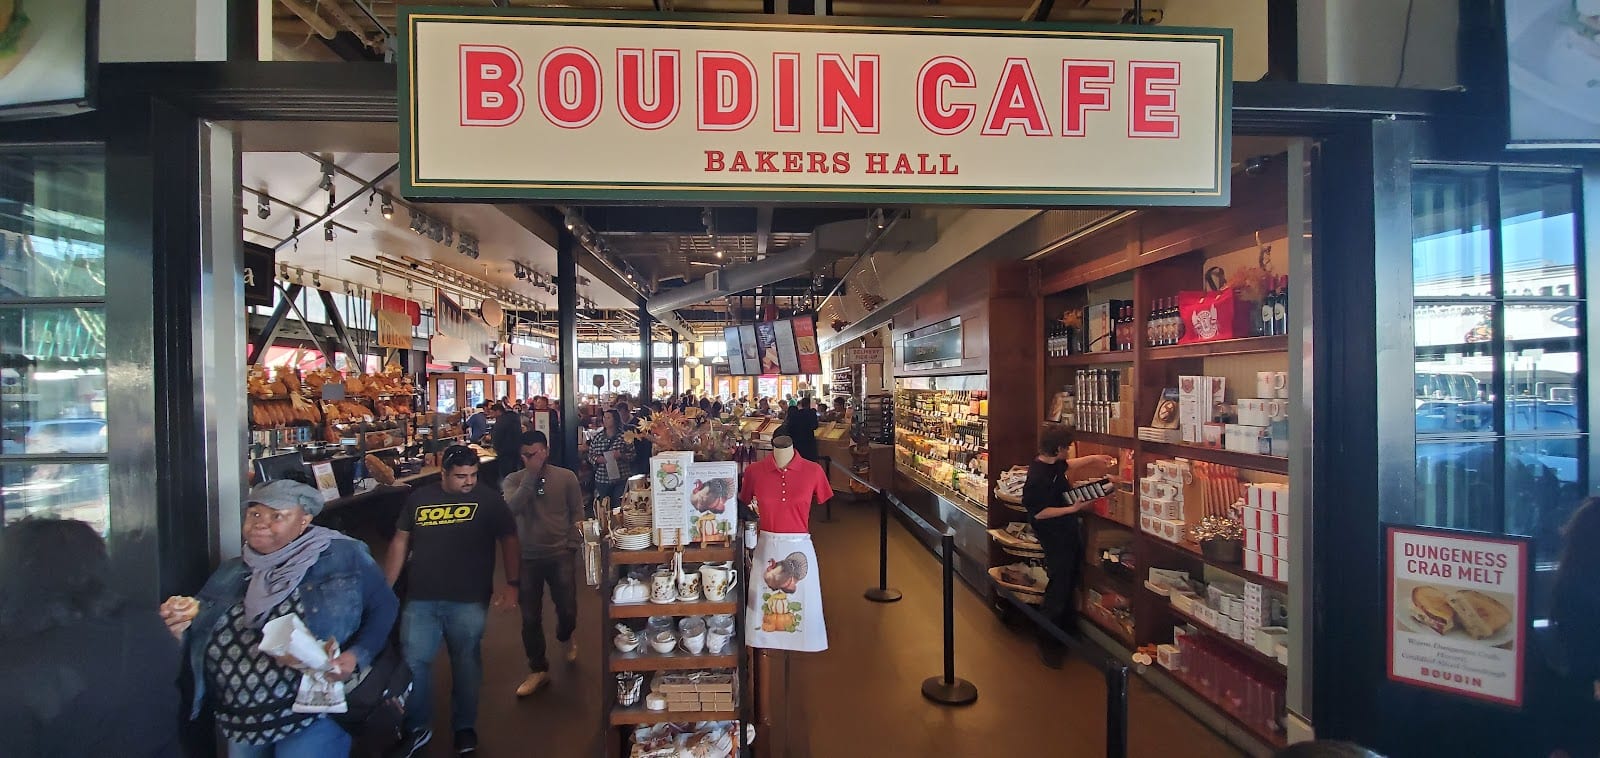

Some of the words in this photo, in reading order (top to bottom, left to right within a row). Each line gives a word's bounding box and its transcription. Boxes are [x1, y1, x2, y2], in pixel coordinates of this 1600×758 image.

[459, 44, 881, 134] BOUDIN
[916, 55, 1182, 139] CAFE
[705, 150, 850, 174] BAKERS
[865, 152, 960, 176] HALL
[417, 506, 471, 521] SOLO
[1404, 543, 1508, 569] DUNGENESS
[1407, 560, 1452, 578] CRAB
[1458, 566, 1504, 585] MELT
[1421, 667, 1483, 688] BOUDIN
